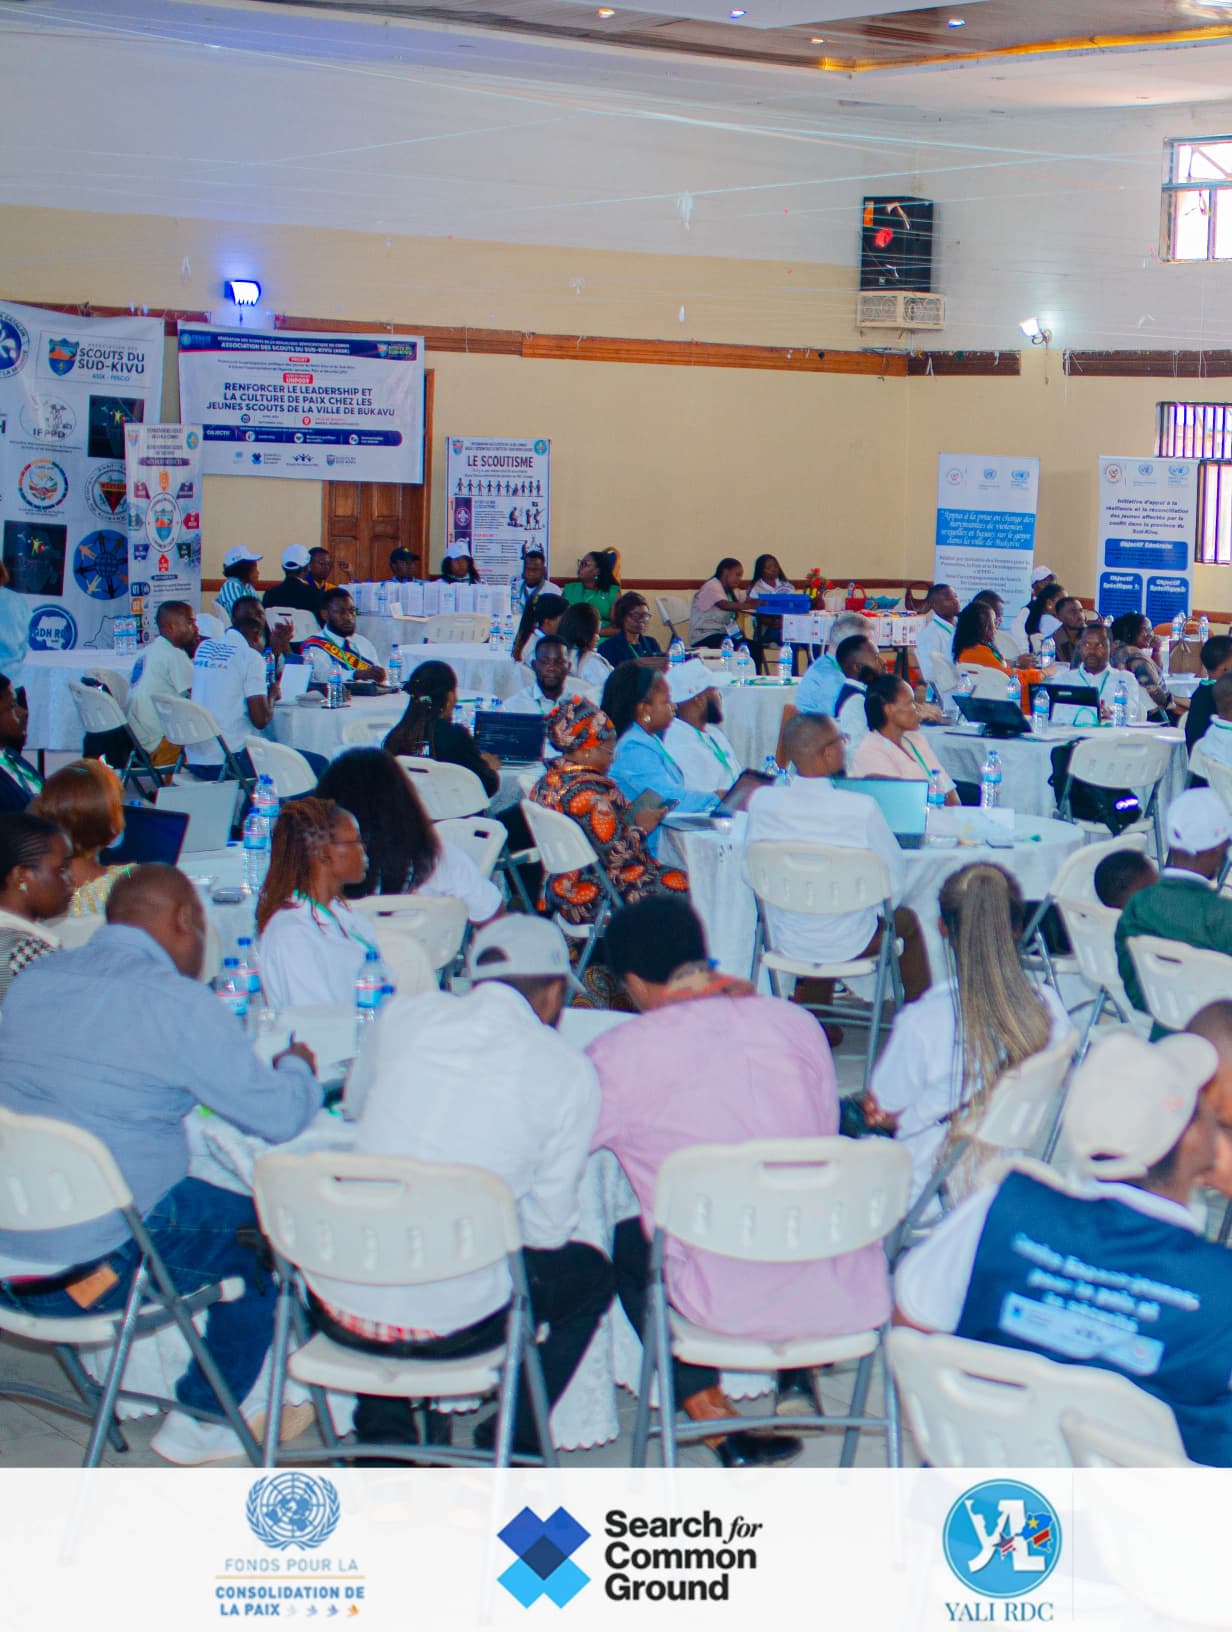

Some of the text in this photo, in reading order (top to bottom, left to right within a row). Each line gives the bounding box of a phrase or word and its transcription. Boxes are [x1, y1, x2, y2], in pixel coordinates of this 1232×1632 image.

[80, 348, 145, 362] SCOUTS DU
[78, 359, 145, 374] SUD-KIVU
[225, 383, 373, 397] RENFORCER LE LEADERSHIP ET
[224, 393, 372, 407] LA CULTURE DE PAIX CHEZ LES
[207, 402, 395, 417] JEUNES SCOUTS DE LA VILLE DE BUKAVU
[468, 456, 534, 468] LE SCOUTISME
